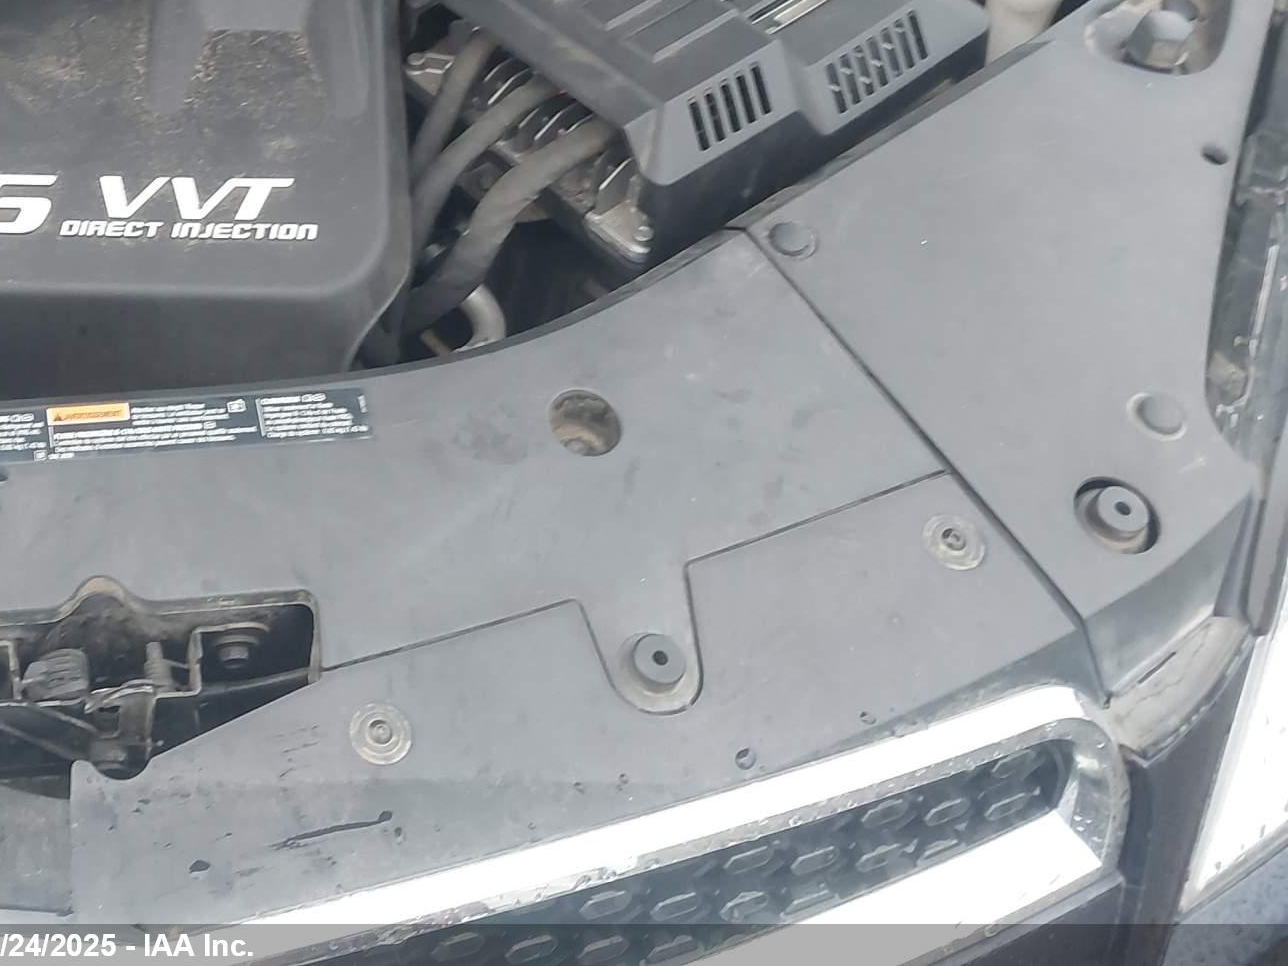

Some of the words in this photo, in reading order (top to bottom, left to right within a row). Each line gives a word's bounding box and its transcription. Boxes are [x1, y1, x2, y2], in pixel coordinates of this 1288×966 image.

[99, 175, 295, 221] VVT
[59, 220, 165, 238] DIRECT
[170, 222, 319, 240] INJECTION
